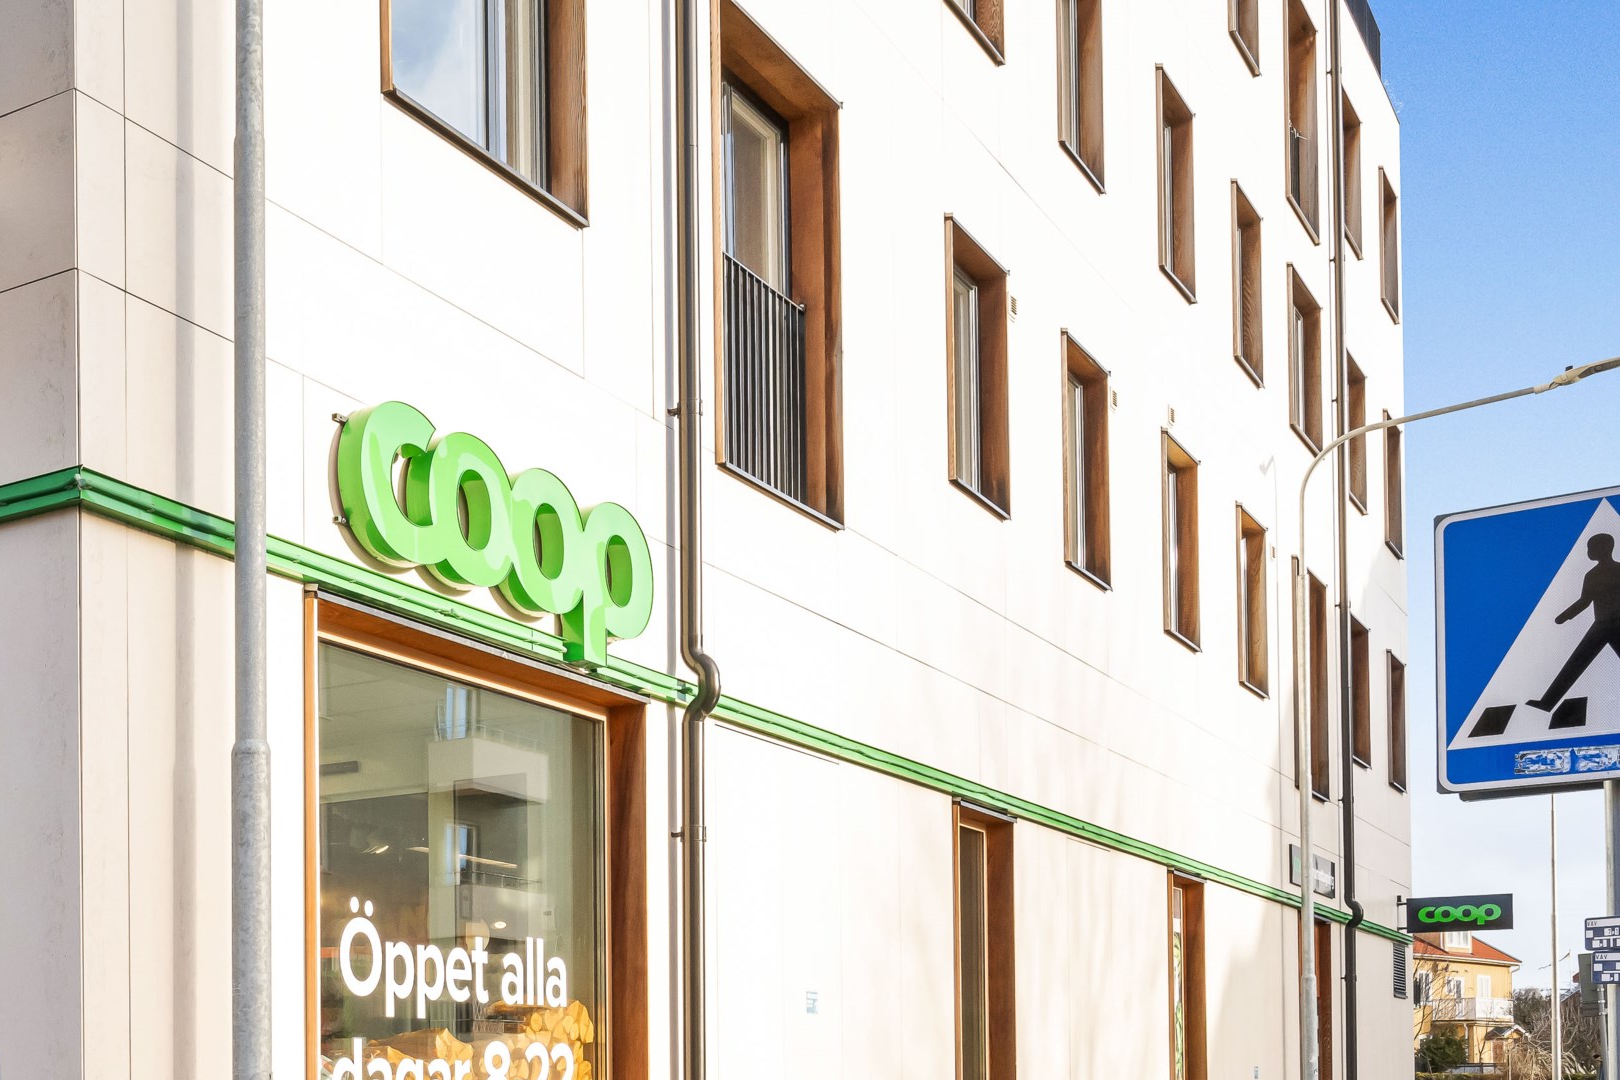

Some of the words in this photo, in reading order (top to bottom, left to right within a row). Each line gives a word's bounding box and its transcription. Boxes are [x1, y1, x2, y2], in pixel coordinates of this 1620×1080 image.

[330, 400, 654, 670] coop
[338, 896, 490, 1019] Öppet
[501, 936, 568, 1008] alla
[1418, 903, 1502, 925] coop
